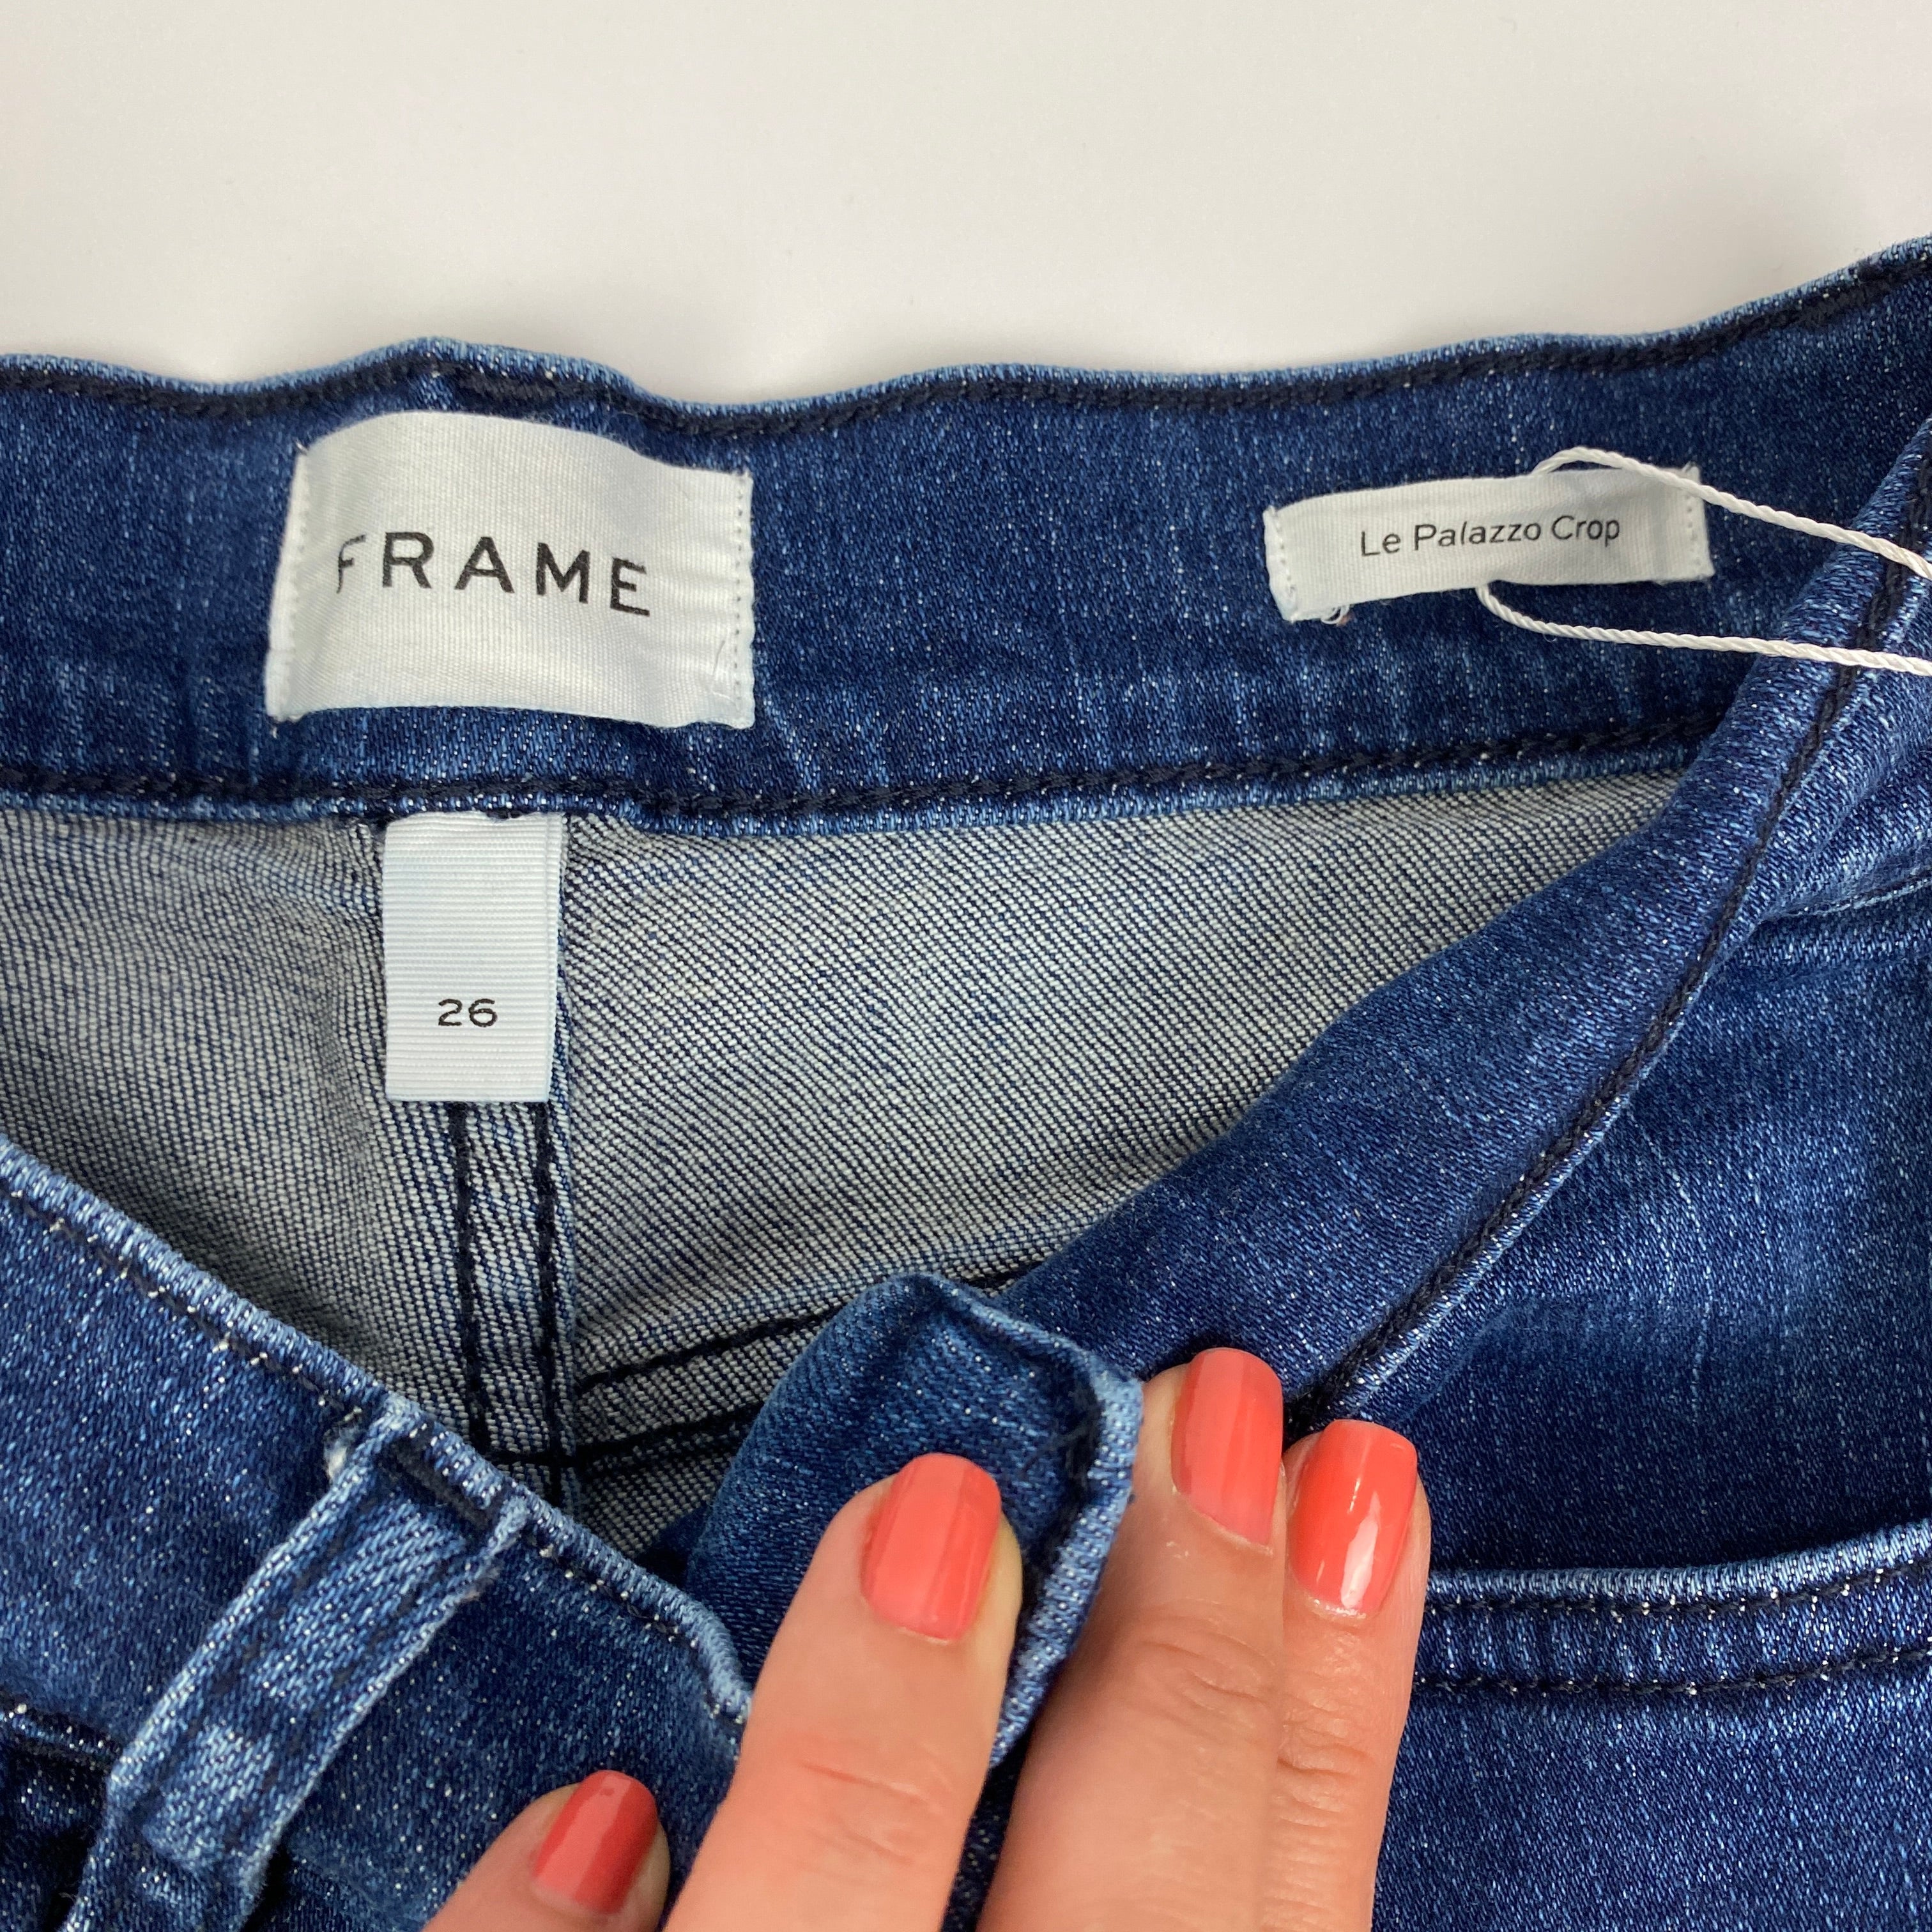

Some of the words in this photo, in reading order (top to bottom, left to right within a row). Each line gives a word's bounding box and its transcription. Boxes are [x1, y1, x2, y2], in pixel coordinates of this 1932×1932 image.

[1360, 530, 1402, 558] Le
[1413, 520, 1542, 553] Palazzo
[1551, 514, 1621, 548] Crop
[335, 530, 651, 618] FRAME
[437, 997, 499, 1029] 26
